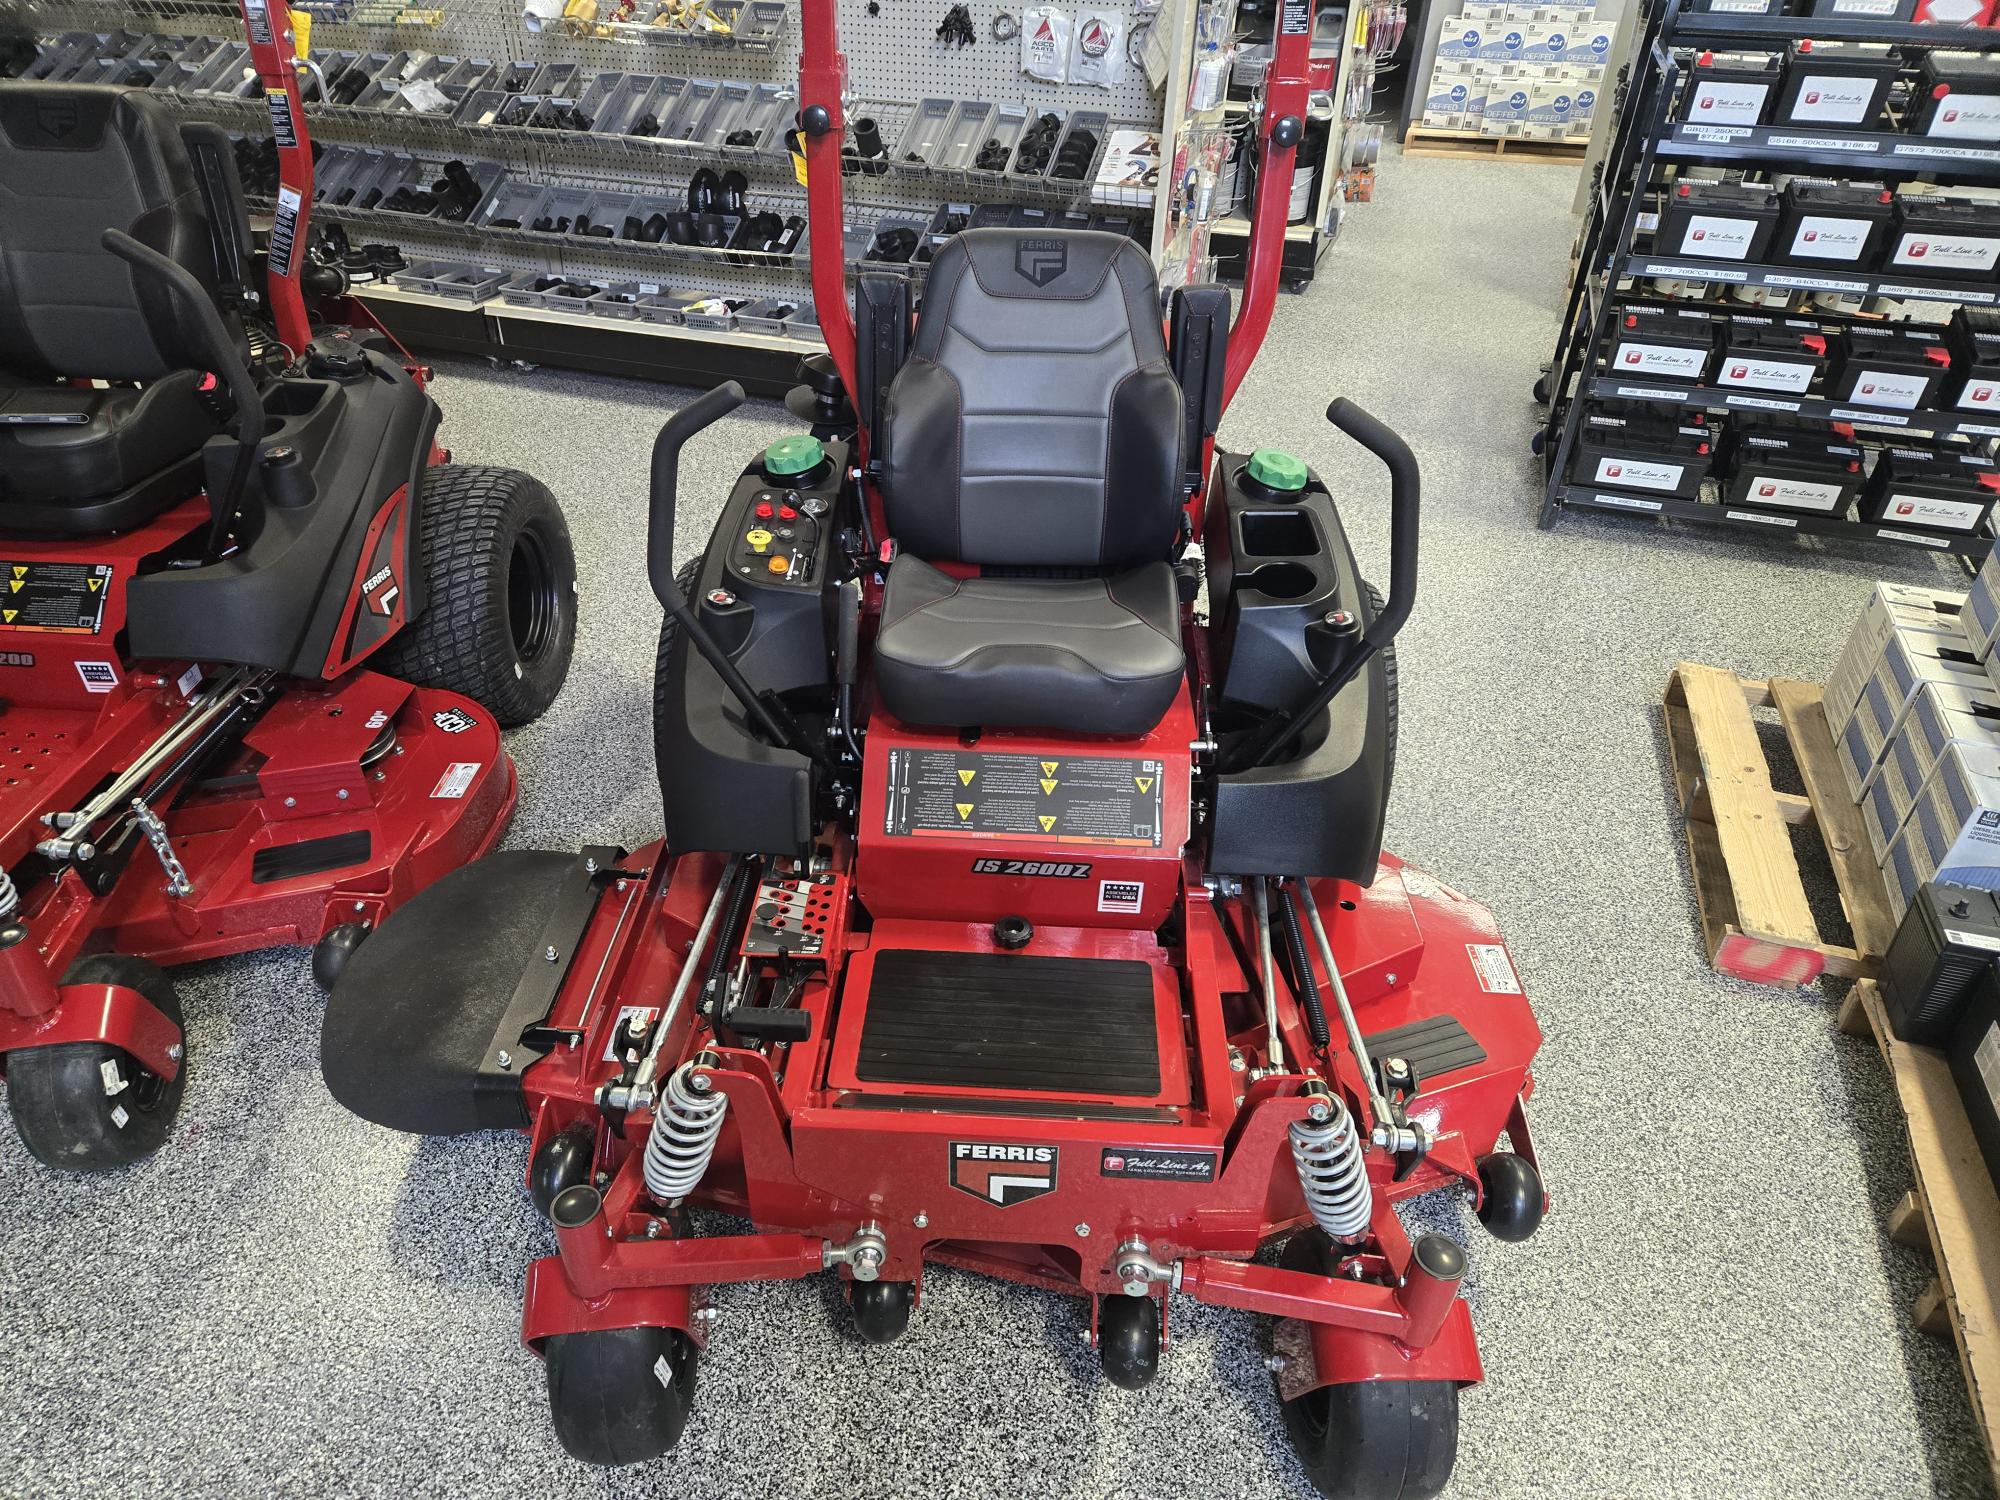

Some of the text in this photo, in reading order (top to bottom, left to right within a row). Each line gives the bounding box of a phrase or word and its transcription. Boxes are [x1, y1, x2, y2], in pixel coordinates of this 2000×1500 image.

[1021, 240, 1064, 250] FERRIS
[1932, 245, 1952, 253] Full
[1953, 246, 1972, 254] Line
[1974, 248, 1988, 256] Ag
[362, 566, 391, 594] FERRIS
[974, 859, 1090, 877] IS 2600Z
[956, 1144, 1051, 1161] FERRIS
[1127, 1158, 1155, 1168] Full
[1156, 1159, 1188, 1169] Line
[1190, 1161, 1210, 1172] Ag
